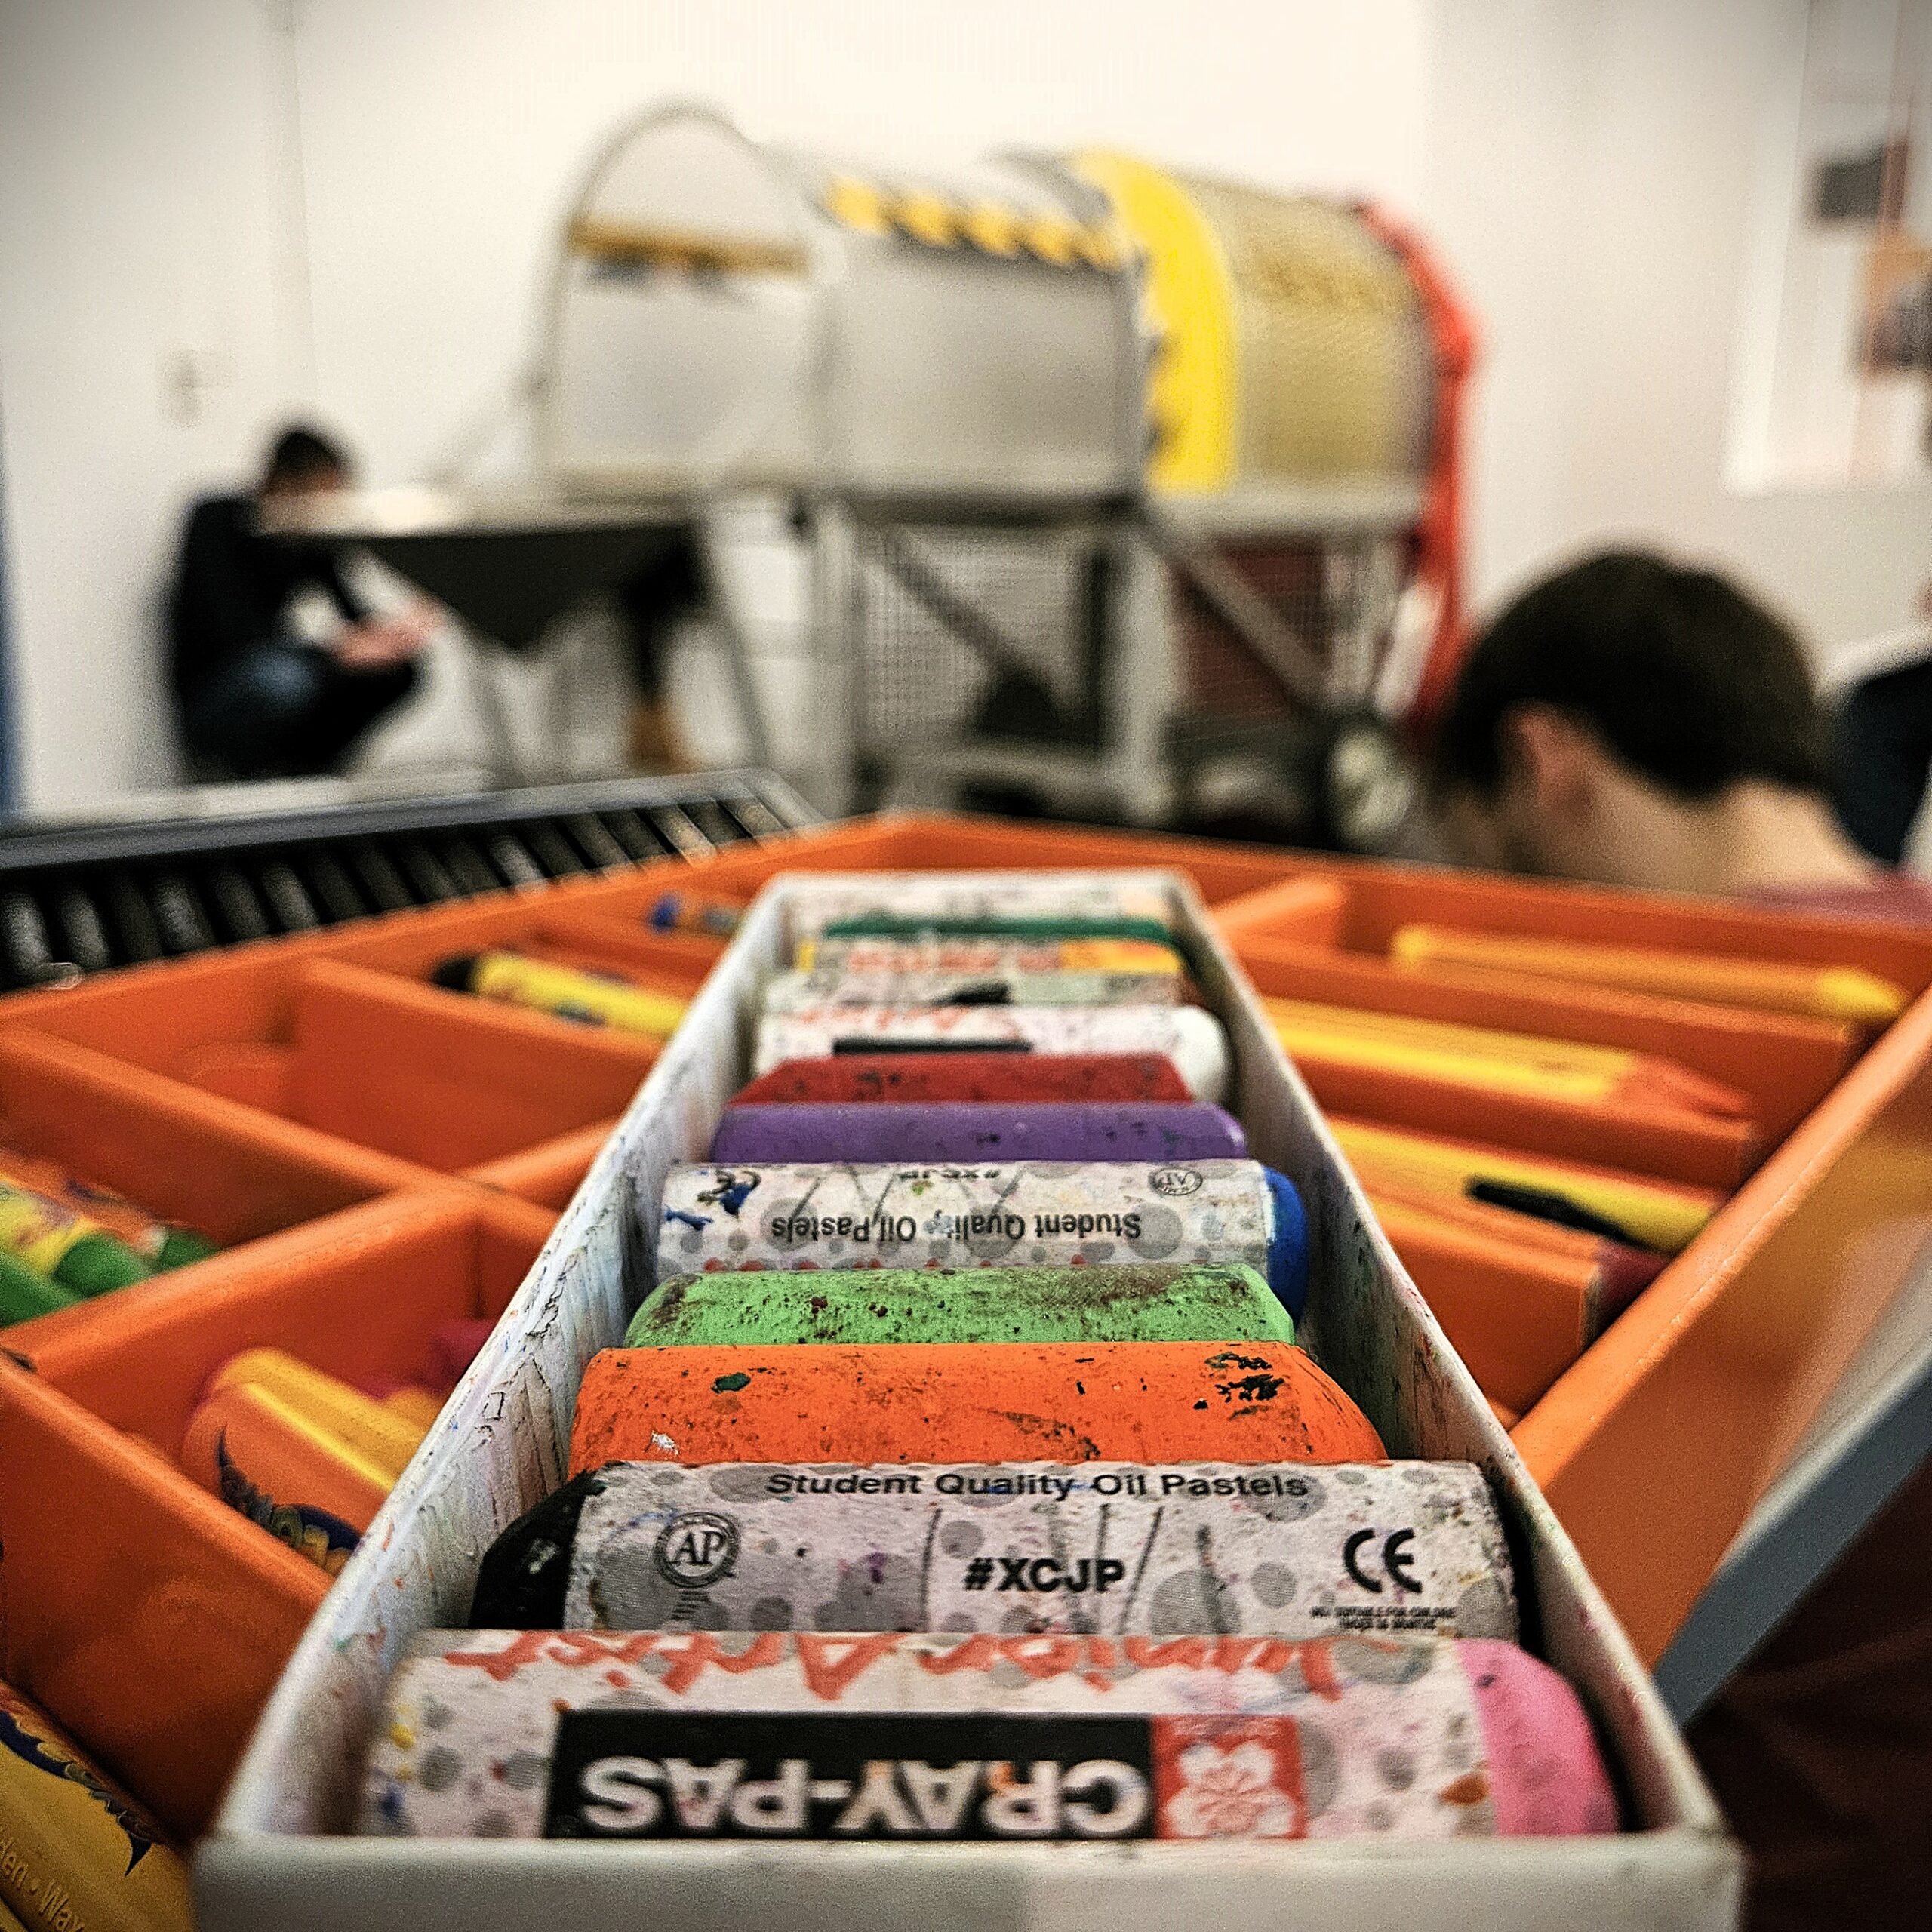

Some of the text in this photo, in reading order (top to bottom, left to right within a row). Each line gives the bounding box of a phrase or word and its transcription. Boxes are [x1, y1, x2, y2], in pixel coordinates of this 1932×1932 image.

[771, 1216, 870, 1243] Pastels
[880, 1215, 916, 1241] Oil
[1035, 1213, 1142, 1239] Student
[765, 1473, 1309, 1501] Student Quality Oil Pastels
[666, 1530, 727, 1566] AP
[1343, 1528, 1423, 1592] CE
[963, 1557, 1125, 1593] #XCJP
[444, 1631, 910, 1702] Artist
[581, 1755, 1152, 1835] CRAY-PAS
